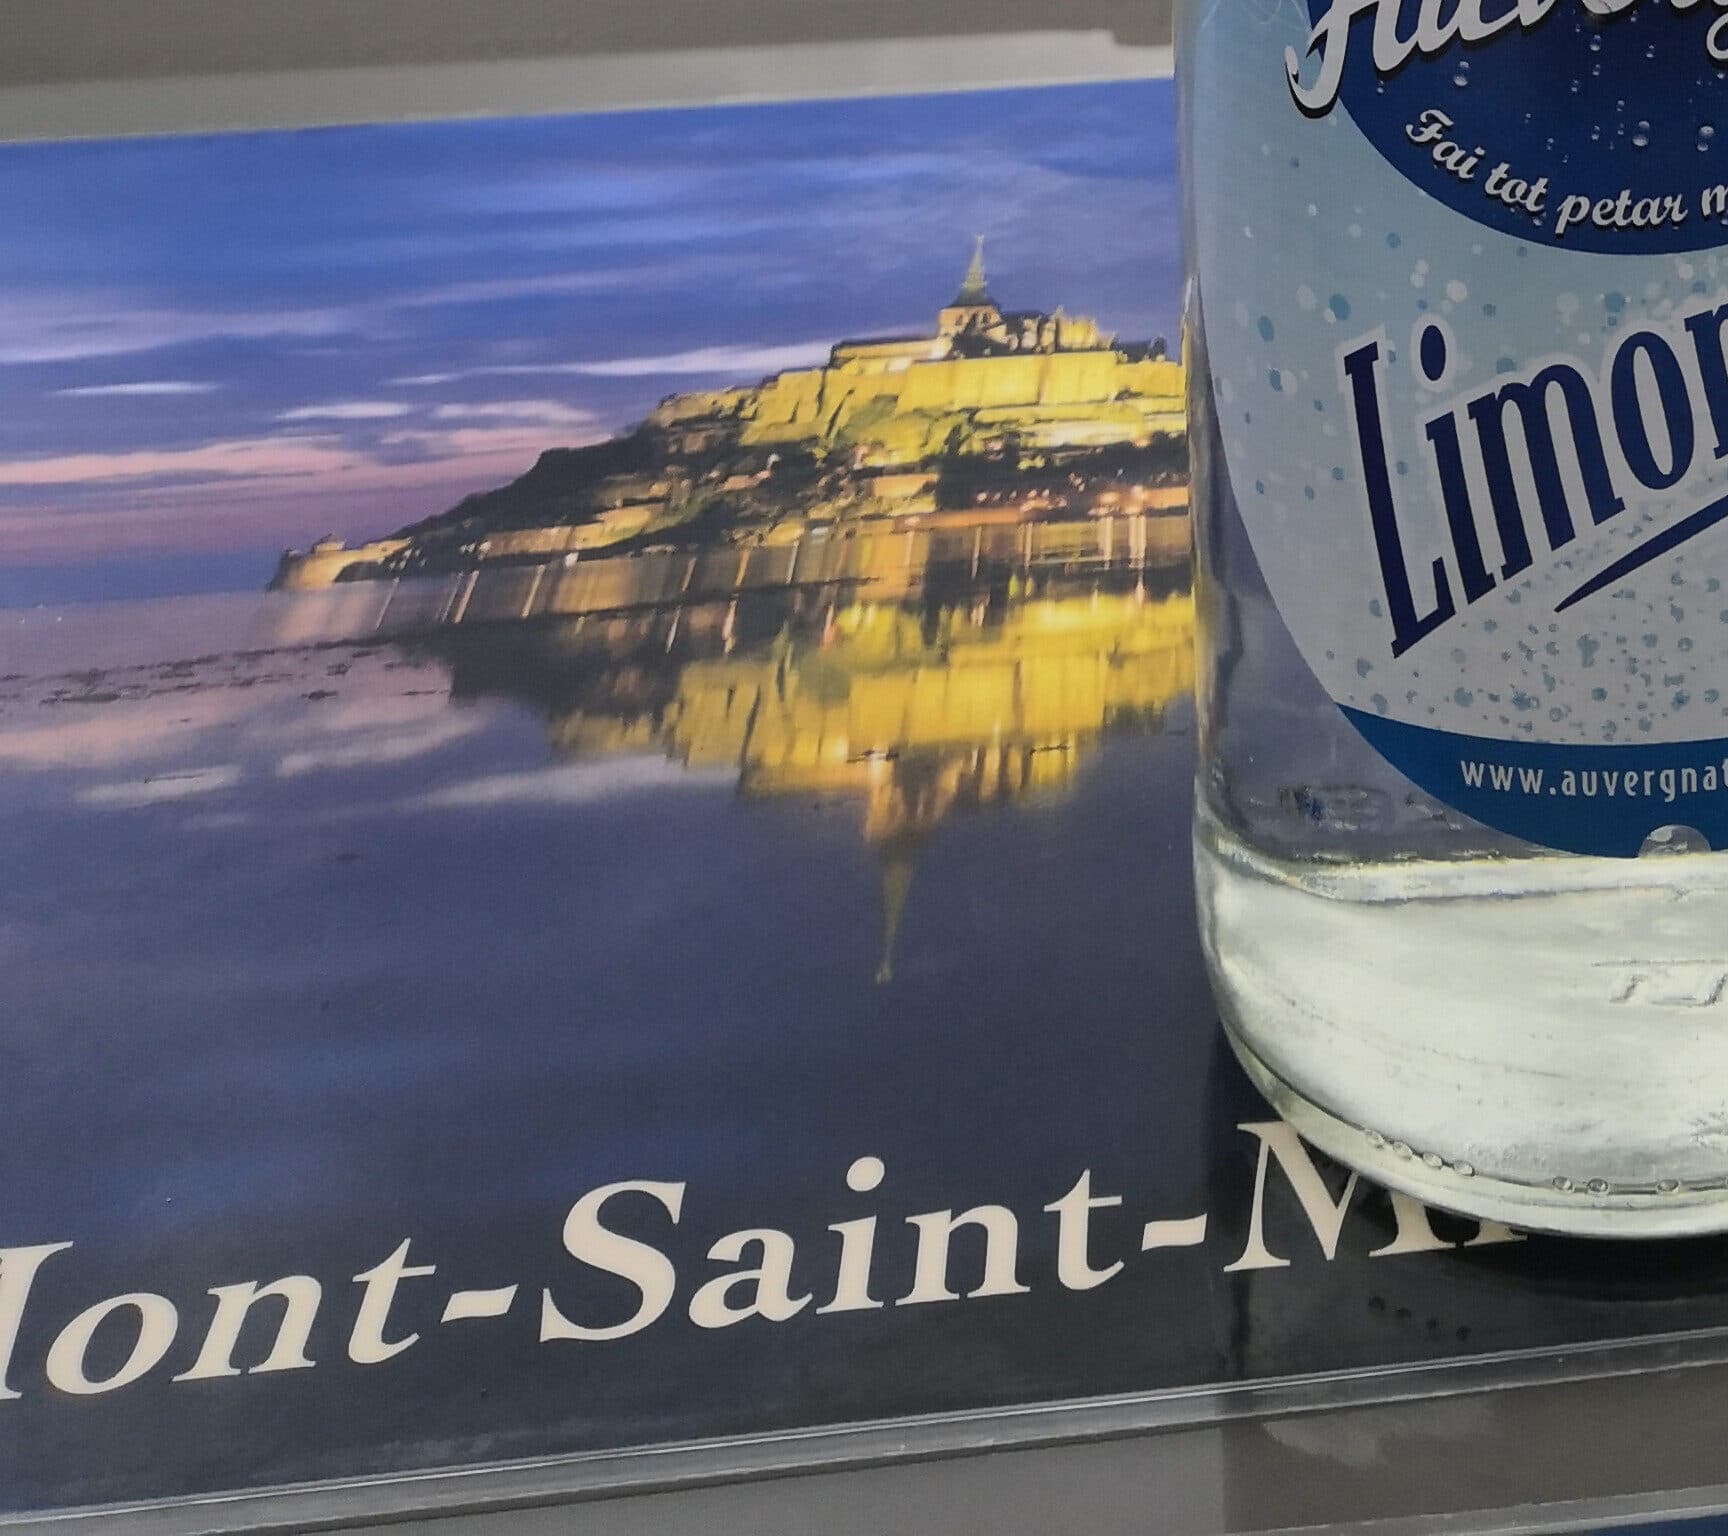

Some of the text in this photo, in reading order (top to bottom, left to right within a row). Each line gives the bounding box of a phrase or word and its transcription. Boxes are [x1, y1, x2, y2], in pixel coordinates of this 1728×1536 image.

[1405, 109, 1486, 179] Fai
[1484, 162, 1549, 212] tot
[1555, 190, 1688, 235] petar
